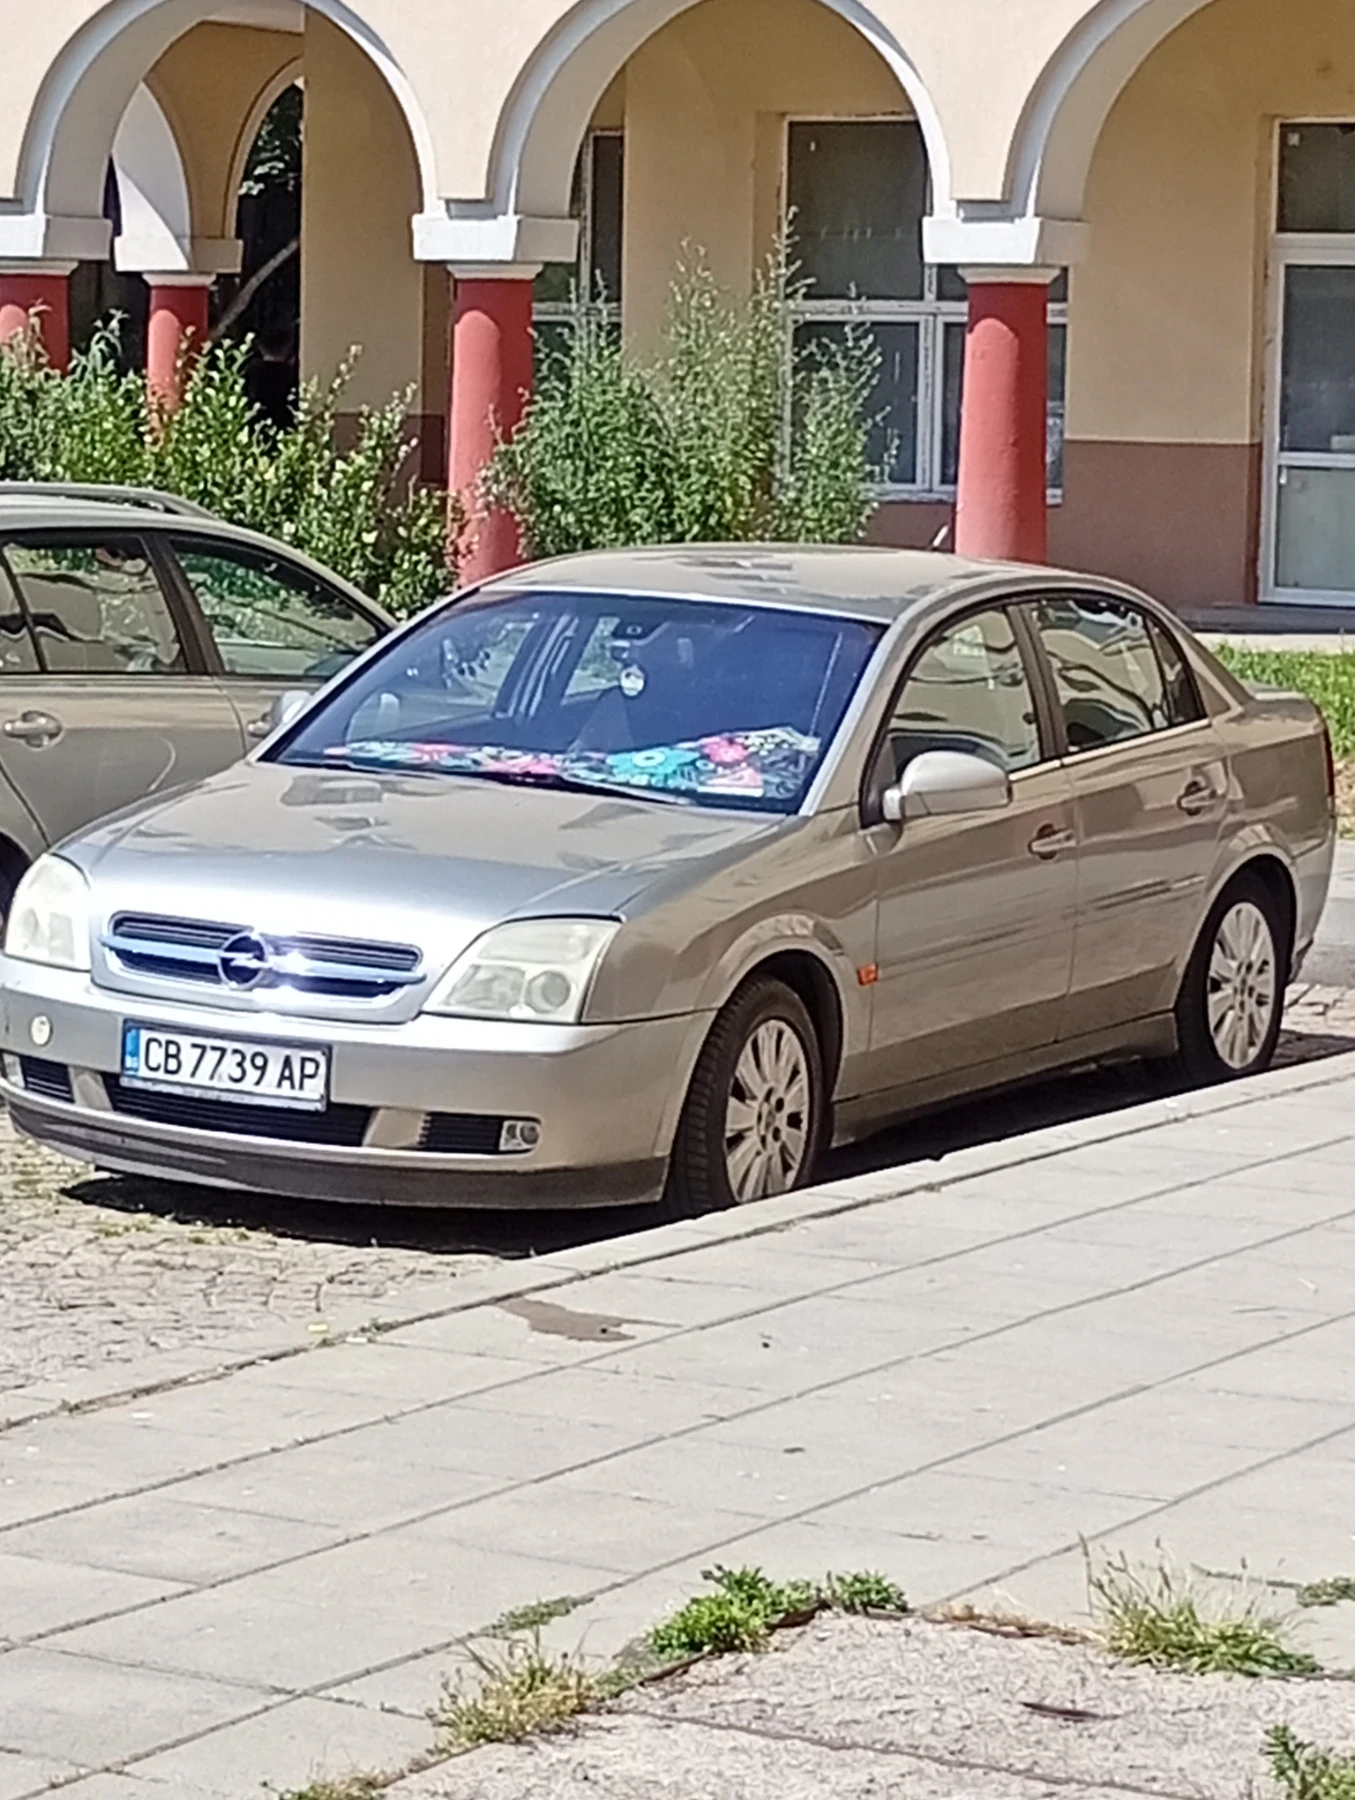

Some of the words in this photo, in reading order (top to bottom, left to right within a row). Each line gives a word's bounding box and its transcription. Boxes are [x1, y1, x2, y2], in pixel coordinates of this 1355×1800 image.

[145, 1037, 183, 1075] CB
[190, 1043, 269, 1086] 7739
[276, 1055, 321, 1091] AP
